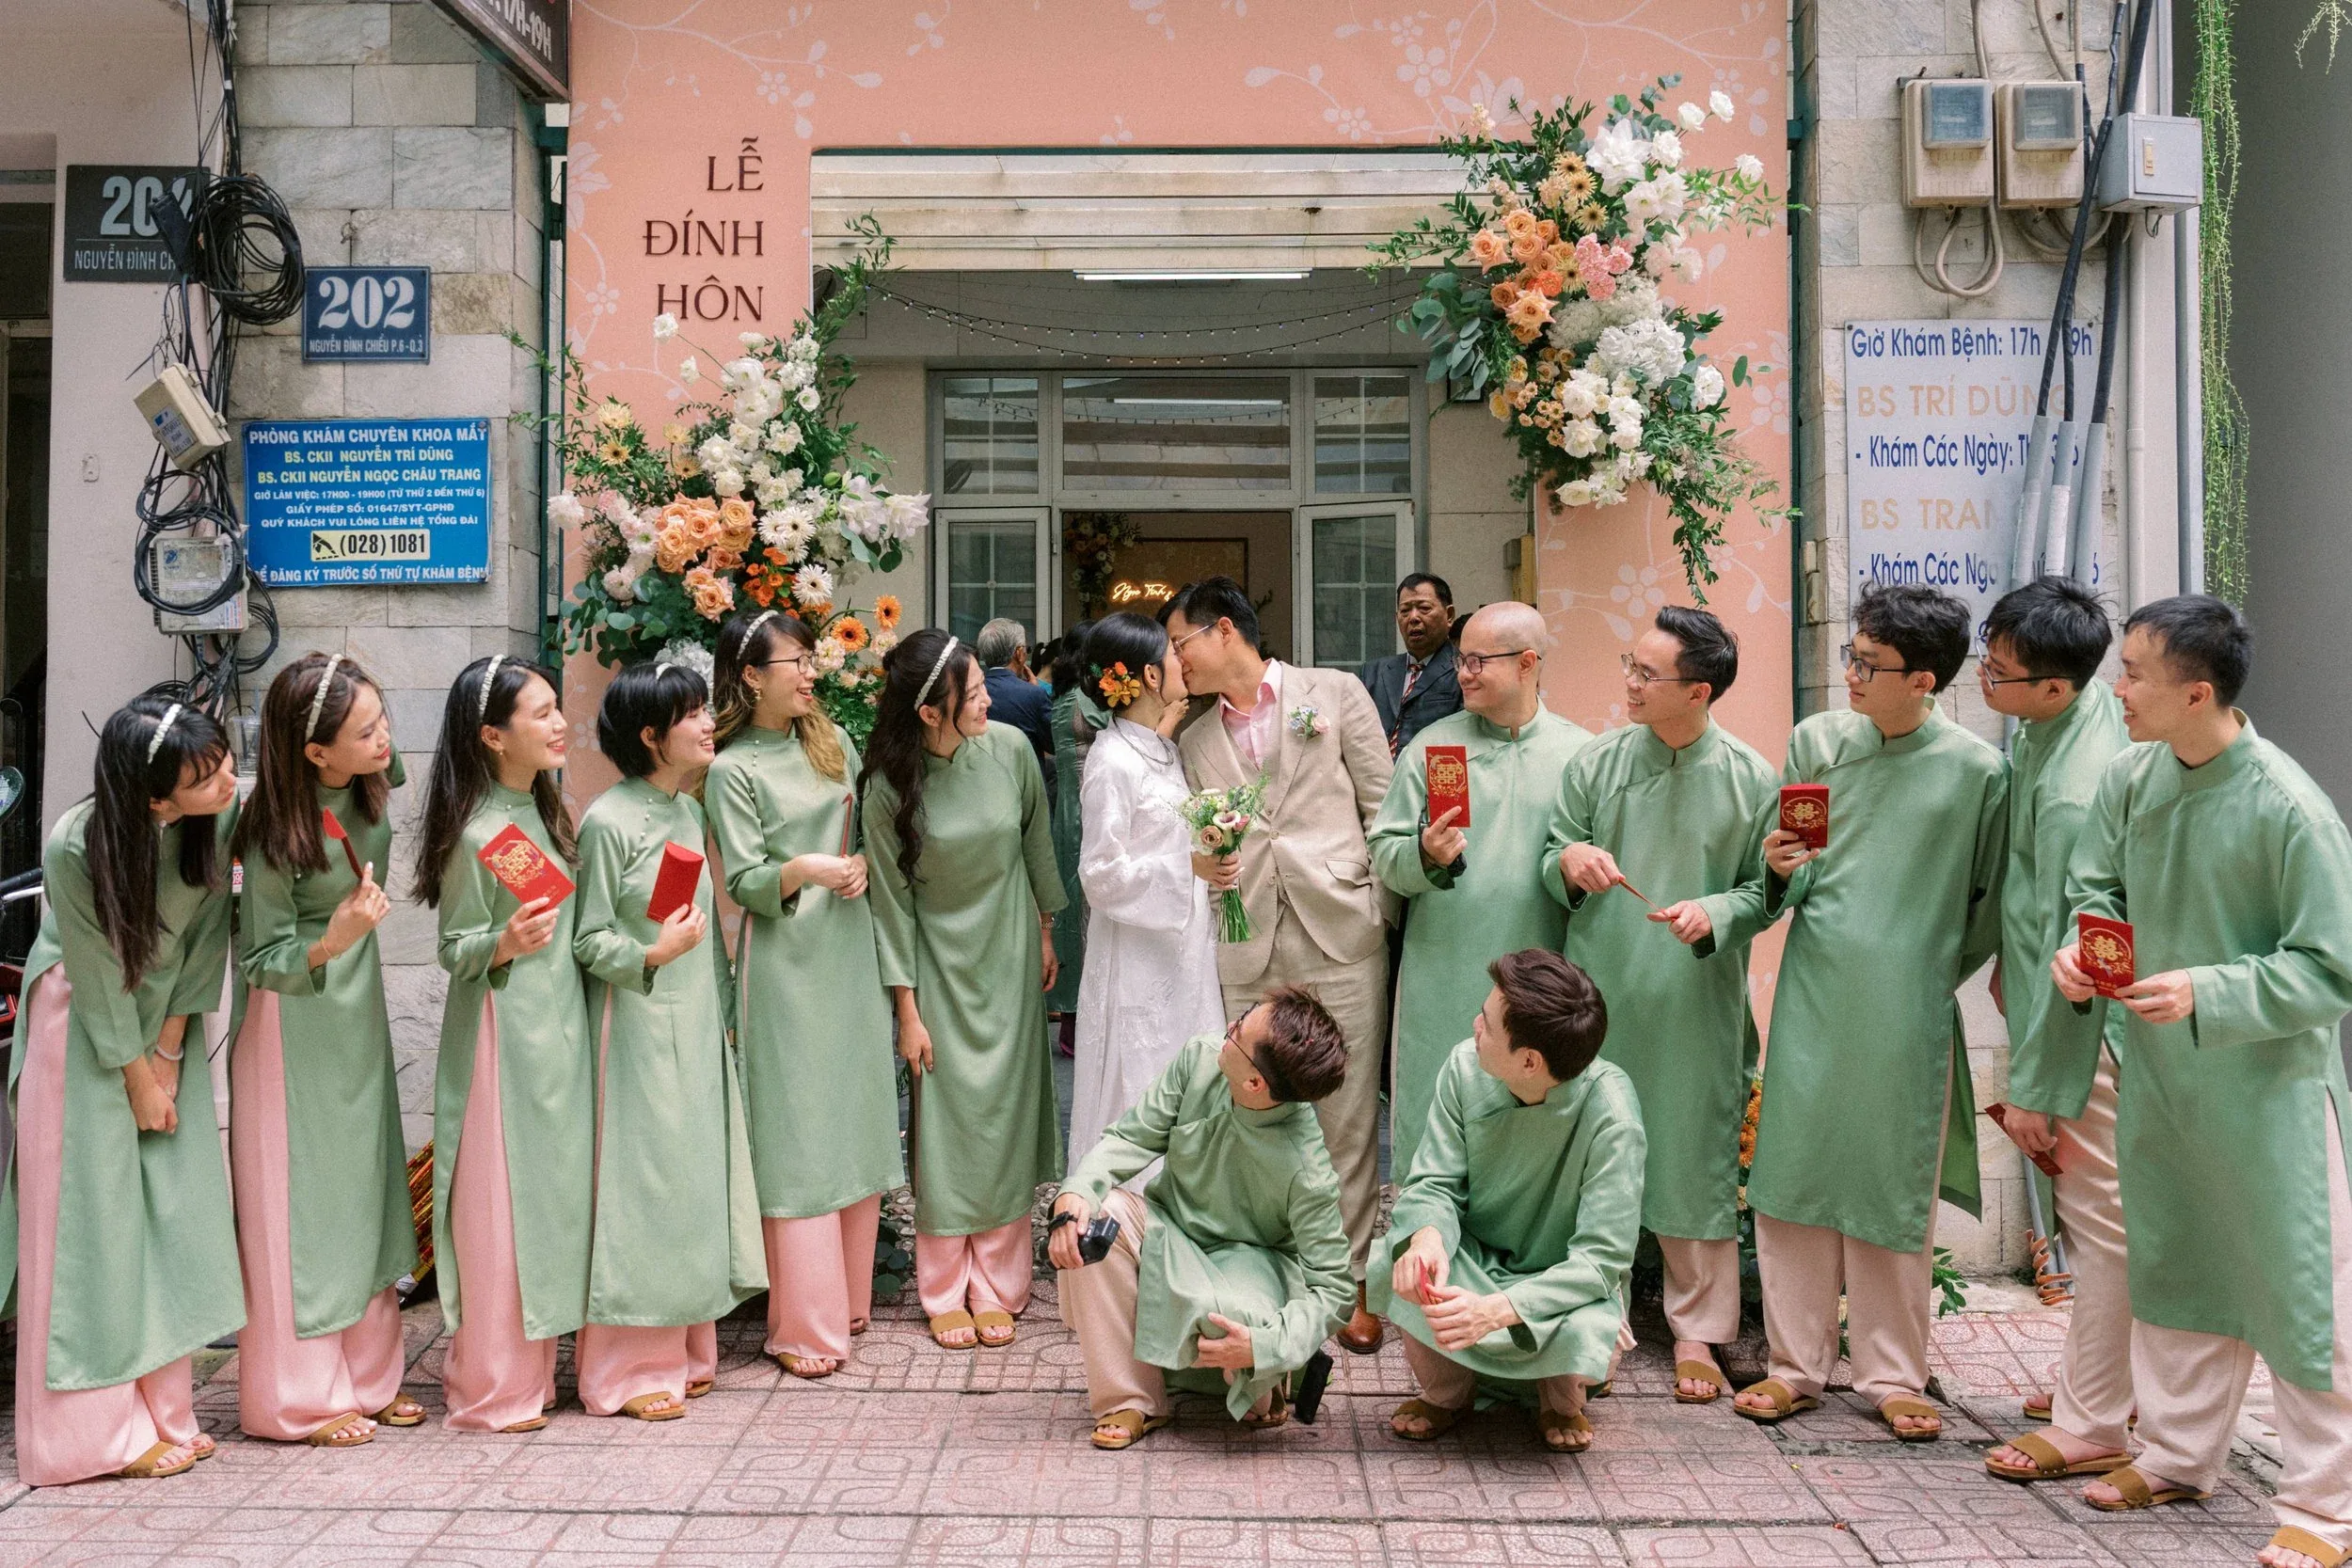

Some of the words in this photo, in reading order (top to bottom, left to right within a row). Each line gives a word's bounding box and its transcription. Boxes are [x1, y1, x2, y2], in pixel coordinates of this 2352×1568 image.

[707, 136, 764, 191] LỄ
[643, 208, 764, 256] ĐÍNH
[74, 244, 124, 270] NGUYỄN
[127, 246, 157, 270] ĐÌNH
[318, 276, 415, 329] 202
[657, 275, 764, 322] HÔN
[309, 333, 342, 353] NGUYỄN
[342, 336, 363, 353] ĐÌNH
[1891, 327, 1946, 357] Khám
[1951, 327, 2003, 363] Bệnh:
[2010, 326, 2041, 356] 17h
[1857, 386, 1897, 418] BS
[1909, 374, 1956, 417] TRÍ
[249, 427, 299, 444] PHÒNG
[303, 426, 345, 443] KHÁM
[348, 426, 408, 443] CHUYÊN
[413, 428, 453, 442] KHOA
[456, 422, 487, 441] MẮT
[284, 451, 305, 463] BS.
[307, 451, 333, 463] CKII
[340, 445, 391, 462] NGUYỄN
[395, 446, 416, 461] TRÍ
[419, 446, 454, 461] DŨNG
[1869, 436, 1918, 467] Khám
[1923, 434, 1958, 467] Các
[1964, 433, 2013, 476] Ngày:
[258, 471, 278, 483] BS.
[280, 470, 306, 483] CKII
[310, 465, 361, 483] NGUYỄN
[364, 469, 400, 485] NGỌC
[402, 467, 437, 481] CHÂU
[439, 468, 482, 481] TRANG
[322, 490, 350, 499] 17H00
[358, 490, 386, 499] 19H00
[426, 489, 433, 498] 2
[287, 516, 326, 528] KHÁCH
[328, 518, 347, 527] VUI
[350, 515, 379, 527] LÒNG
[383, 516, 407, 526] LIÊN
[410, 515, 425, 527] HỆ
[315, 505, 344, 514] PHÉP
[1861, 499, 1899, 530] BS
[1918, 499, 1992, 531] TRA
[270, 568, 301, 581] ĐĂNG
[304, 566, 320, 580] KÝ
[323, 565, 359, 580] TRƯỚC
[362, 564, 377, 579] SỐ
[380, 564, 404, 579] THỨ
[405, 565, 421, 582] TỰ
[422, 564, 454, 578] KHÁM
[1871, 553, 1918, 585] Khám
[1925, 553, 1960, 585] Các
